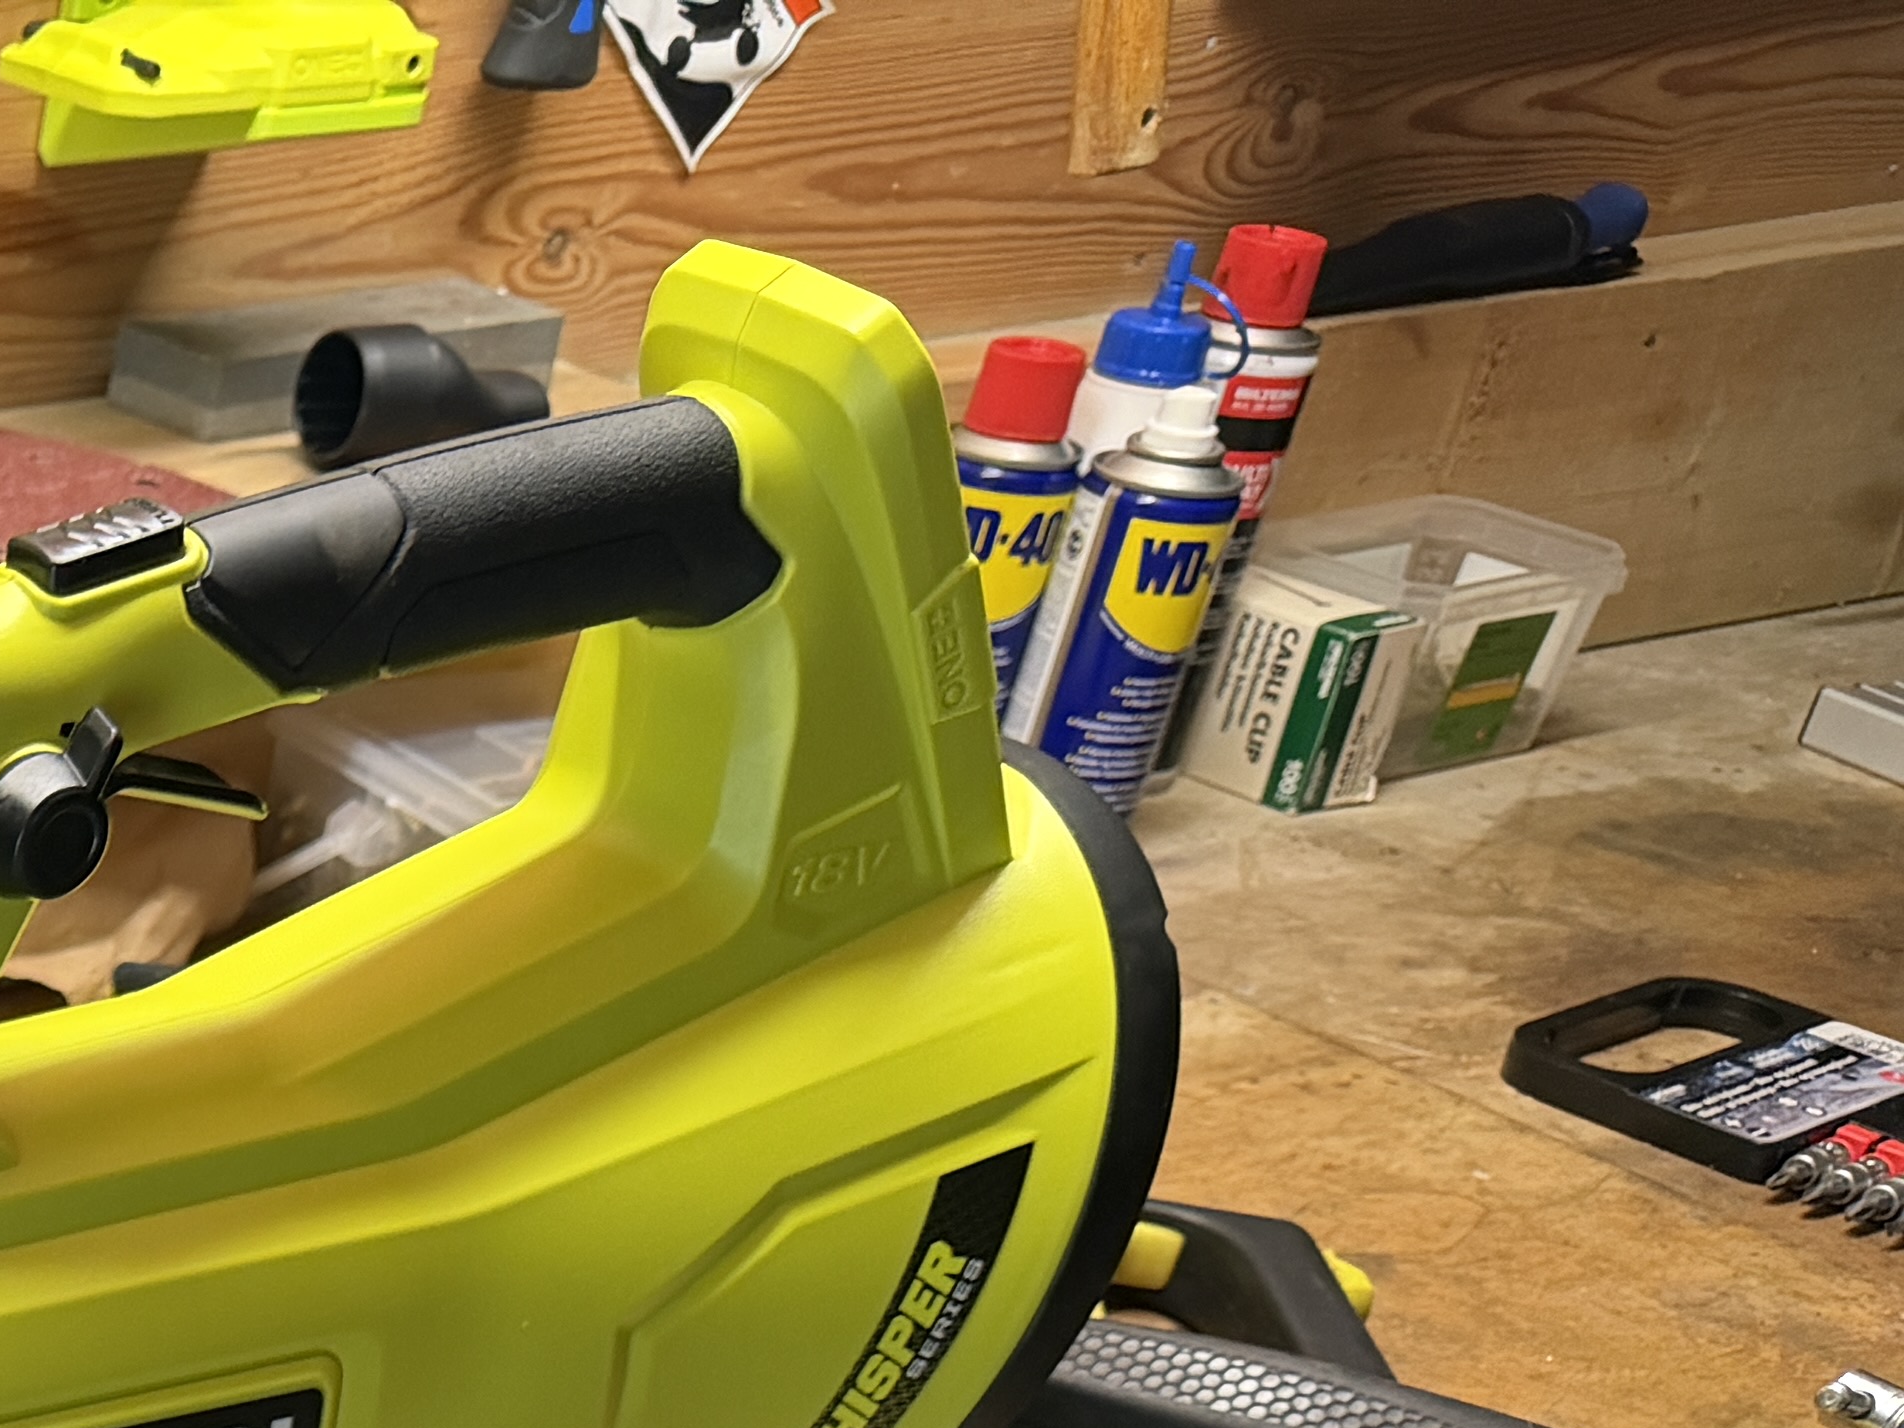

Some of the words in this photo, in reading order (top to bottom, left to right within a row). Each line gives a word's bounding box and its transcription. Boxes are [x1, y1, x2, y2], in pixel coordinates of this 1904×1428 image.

[963, 505, 1067, 569] D-40
[1259, 626, 1301, 704] CABLE
[905, 1257, 985, 1380] SERIES
